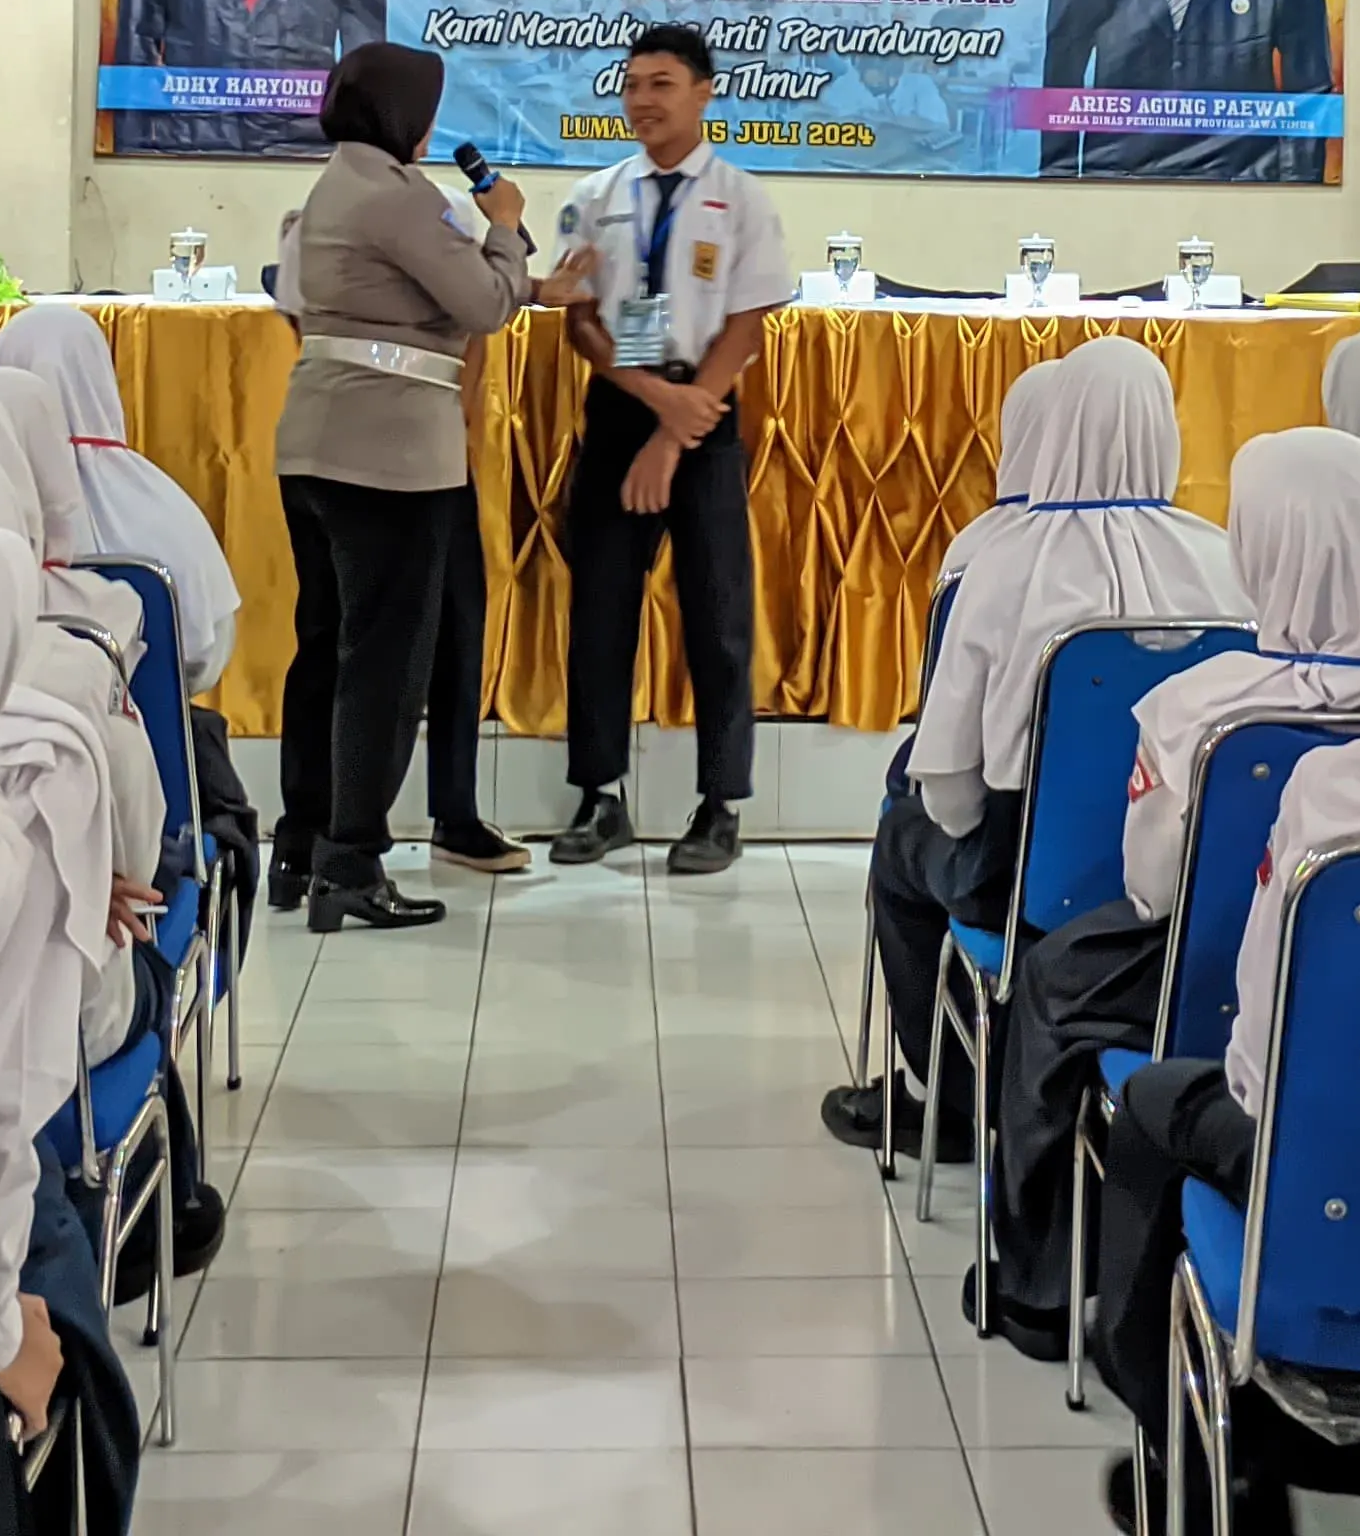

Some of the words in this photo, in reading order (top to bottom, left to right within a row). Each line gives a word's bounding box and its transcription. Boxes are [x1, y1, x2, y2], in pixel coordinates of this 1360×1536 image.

[424, 8, 506, 48] Kami
[509, 10, 700, 49] Menduk
[704, 16, 771, 52] Anti
[778, 19, 1003, 63] Perundungan
[162, 75, 219, 93] ADHY
[594, 61, 627, 97] di
[244, 98, 273, 107] JAWA
[276, 99, 312, 109] TIMUR
[1069, 95, 1131, 113] ARIES
[1137, 97, 1207, 115] AGUNG
[1213, 99, 1296, 118] PAEWAI
[735, 121, 801, 145] JULI
[807, 123, 876, 146] 2024
